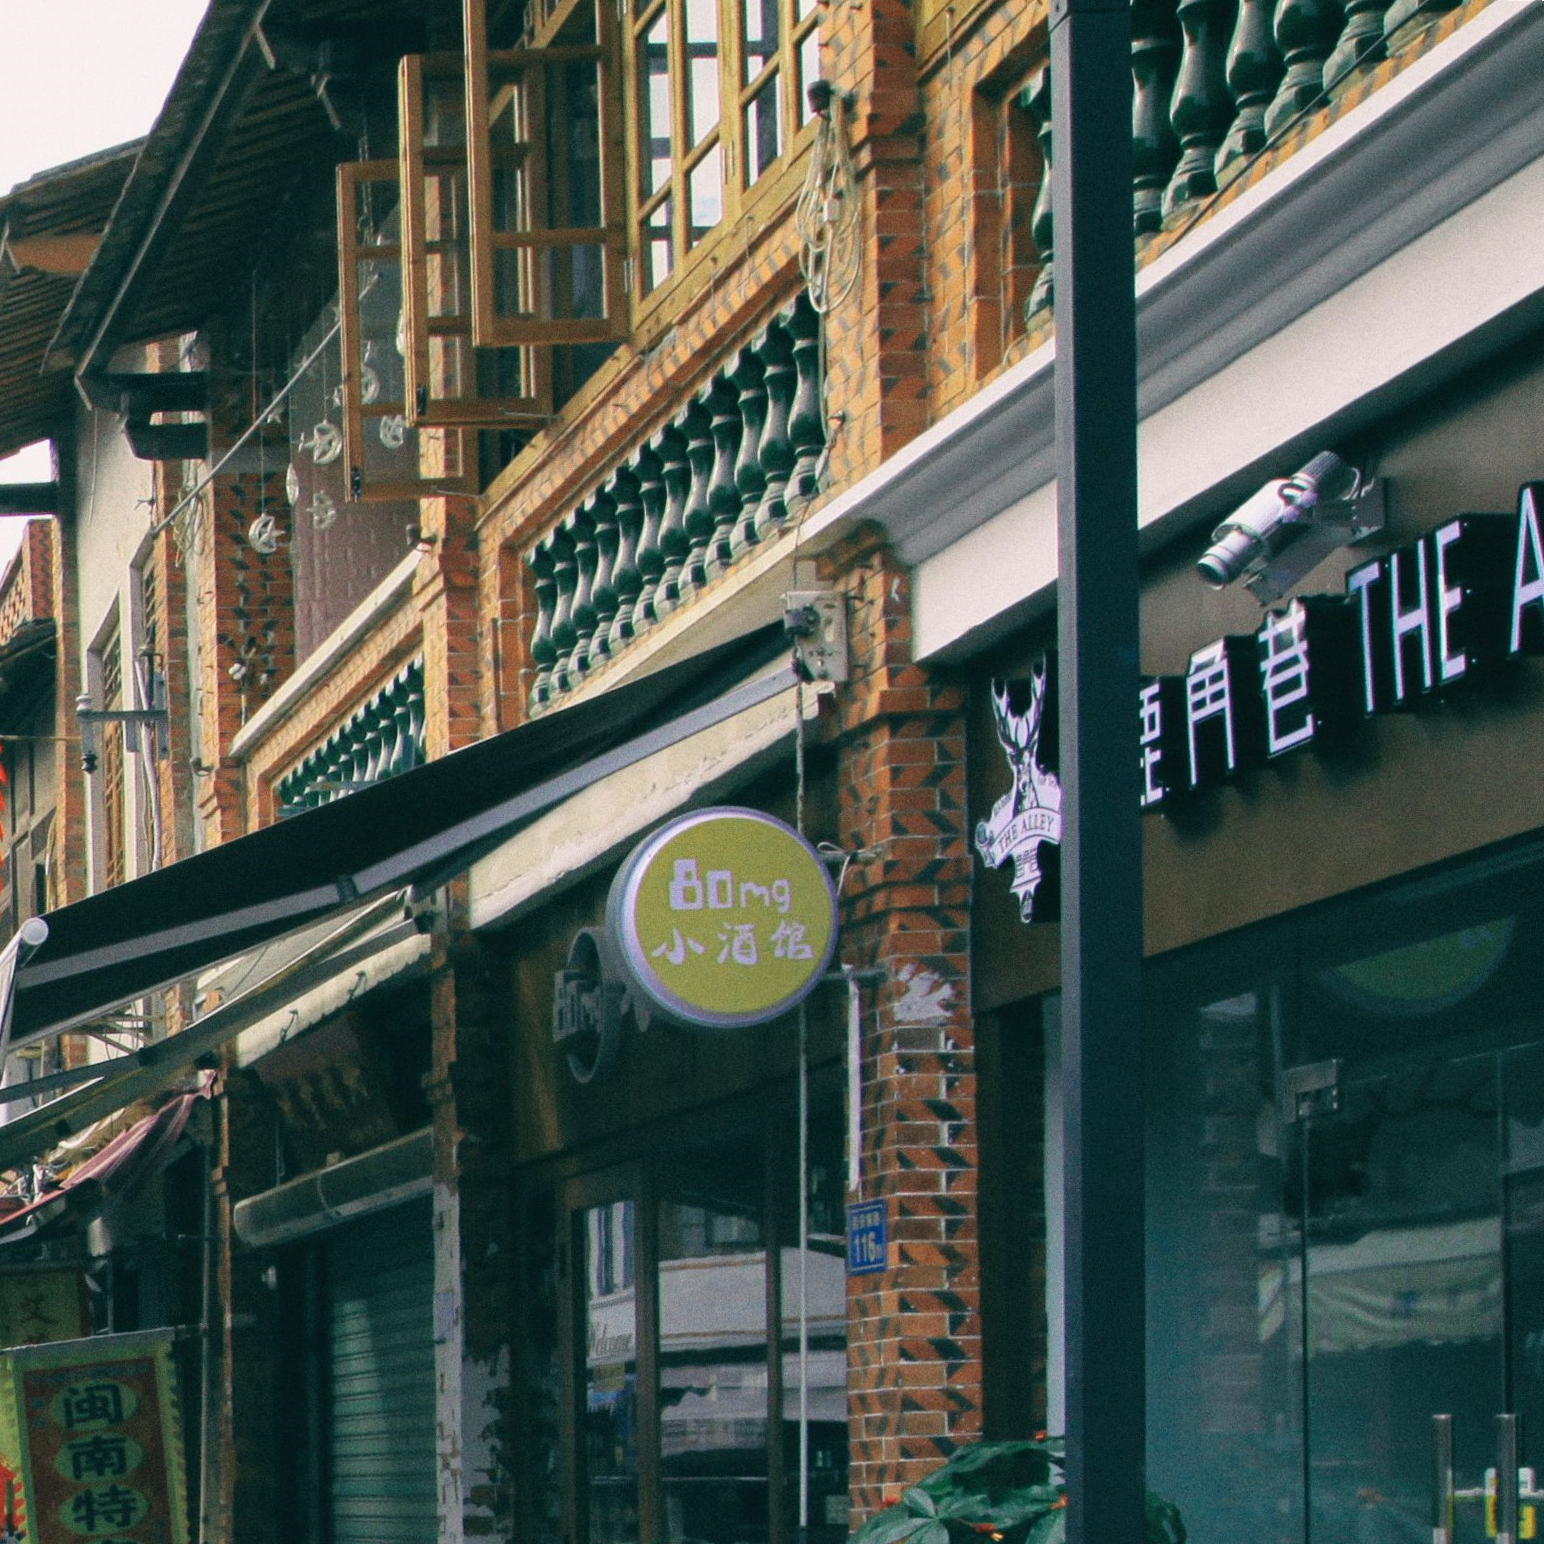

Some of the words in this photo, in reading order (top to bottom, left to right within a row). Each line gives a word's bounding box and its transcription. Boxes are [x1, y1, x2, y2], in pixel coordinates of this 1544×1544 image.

[1348, 520, 1465, 713] THE
[998, 824, 1018, 853] THE
[1021, 813, 1054, 833] ALLEY
[651, 920, 814, 965] 小酒馆
